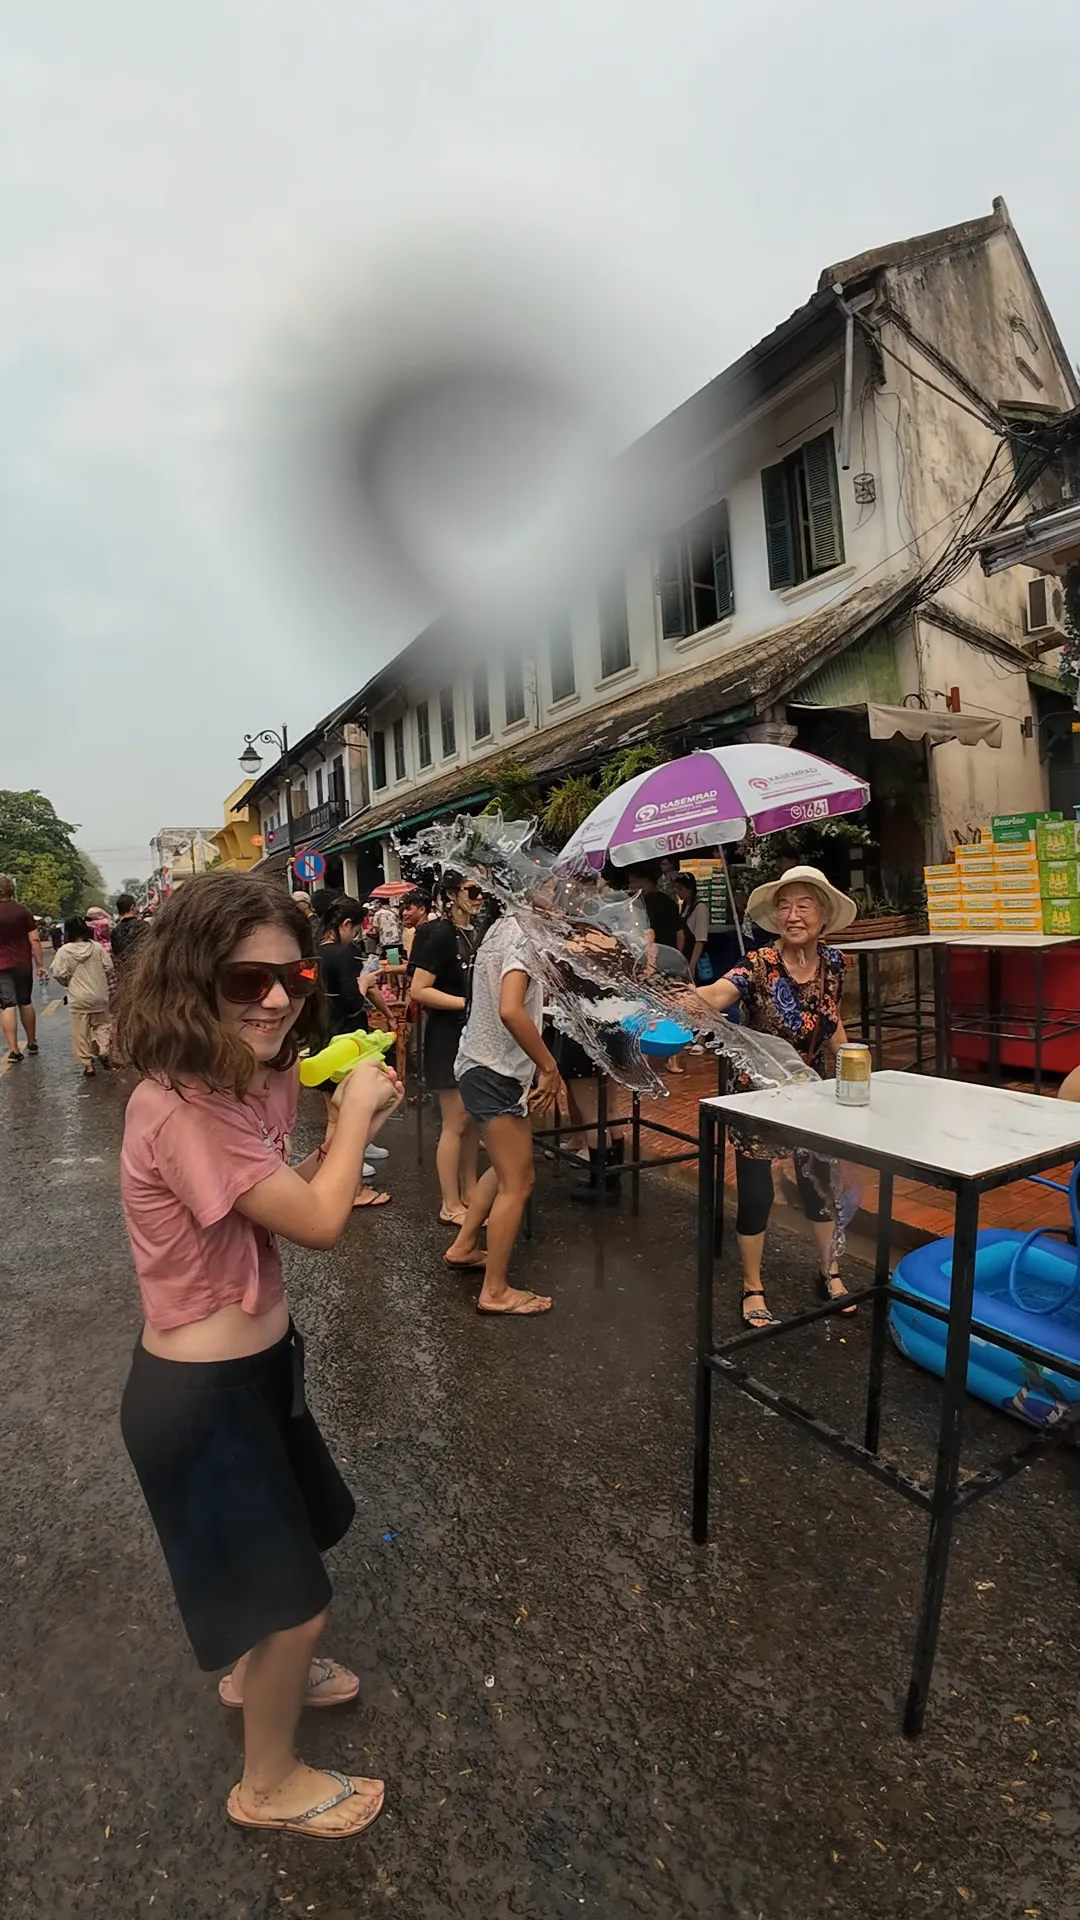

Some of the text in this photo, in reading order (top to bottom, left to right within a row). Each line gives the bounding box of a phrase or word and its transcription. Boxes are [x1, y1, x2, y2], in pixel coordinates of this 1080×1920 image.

[660, 790, 718, 810] KASEMRAD
[801, 801, 827, 819] 1661
[668, 831, 699, 851] 1661
